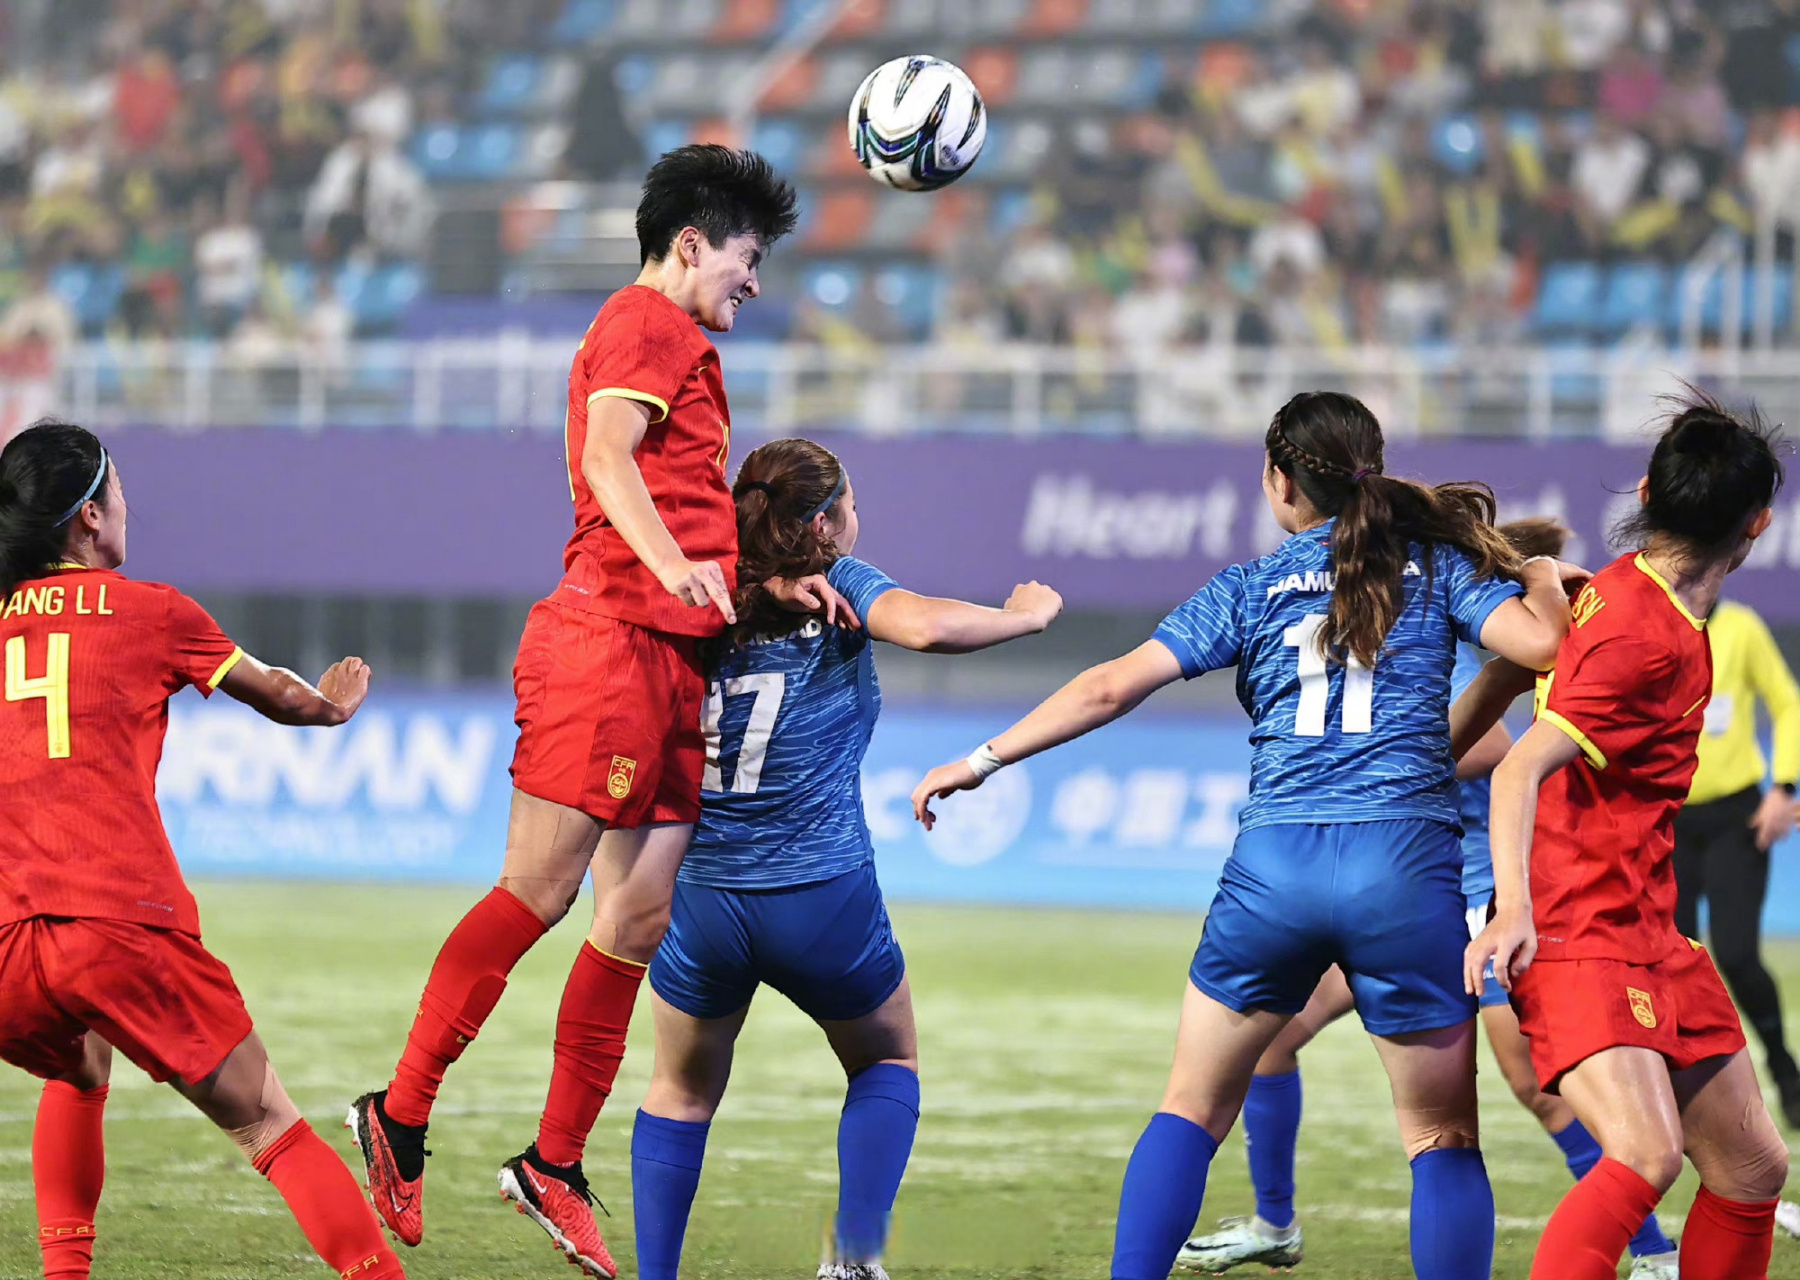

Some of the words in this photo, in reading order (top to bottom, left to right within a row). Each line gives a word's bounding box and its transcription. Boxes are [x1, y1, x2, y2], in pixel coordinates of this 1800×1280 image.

[1022, 472, 1238, 558] Heart
[5, 632, 71, 759] 4
[700, 672, 785, 793] 17
[1283, 614, 1377, 736] 11
[41, 1226, 89, 1237] CFA
